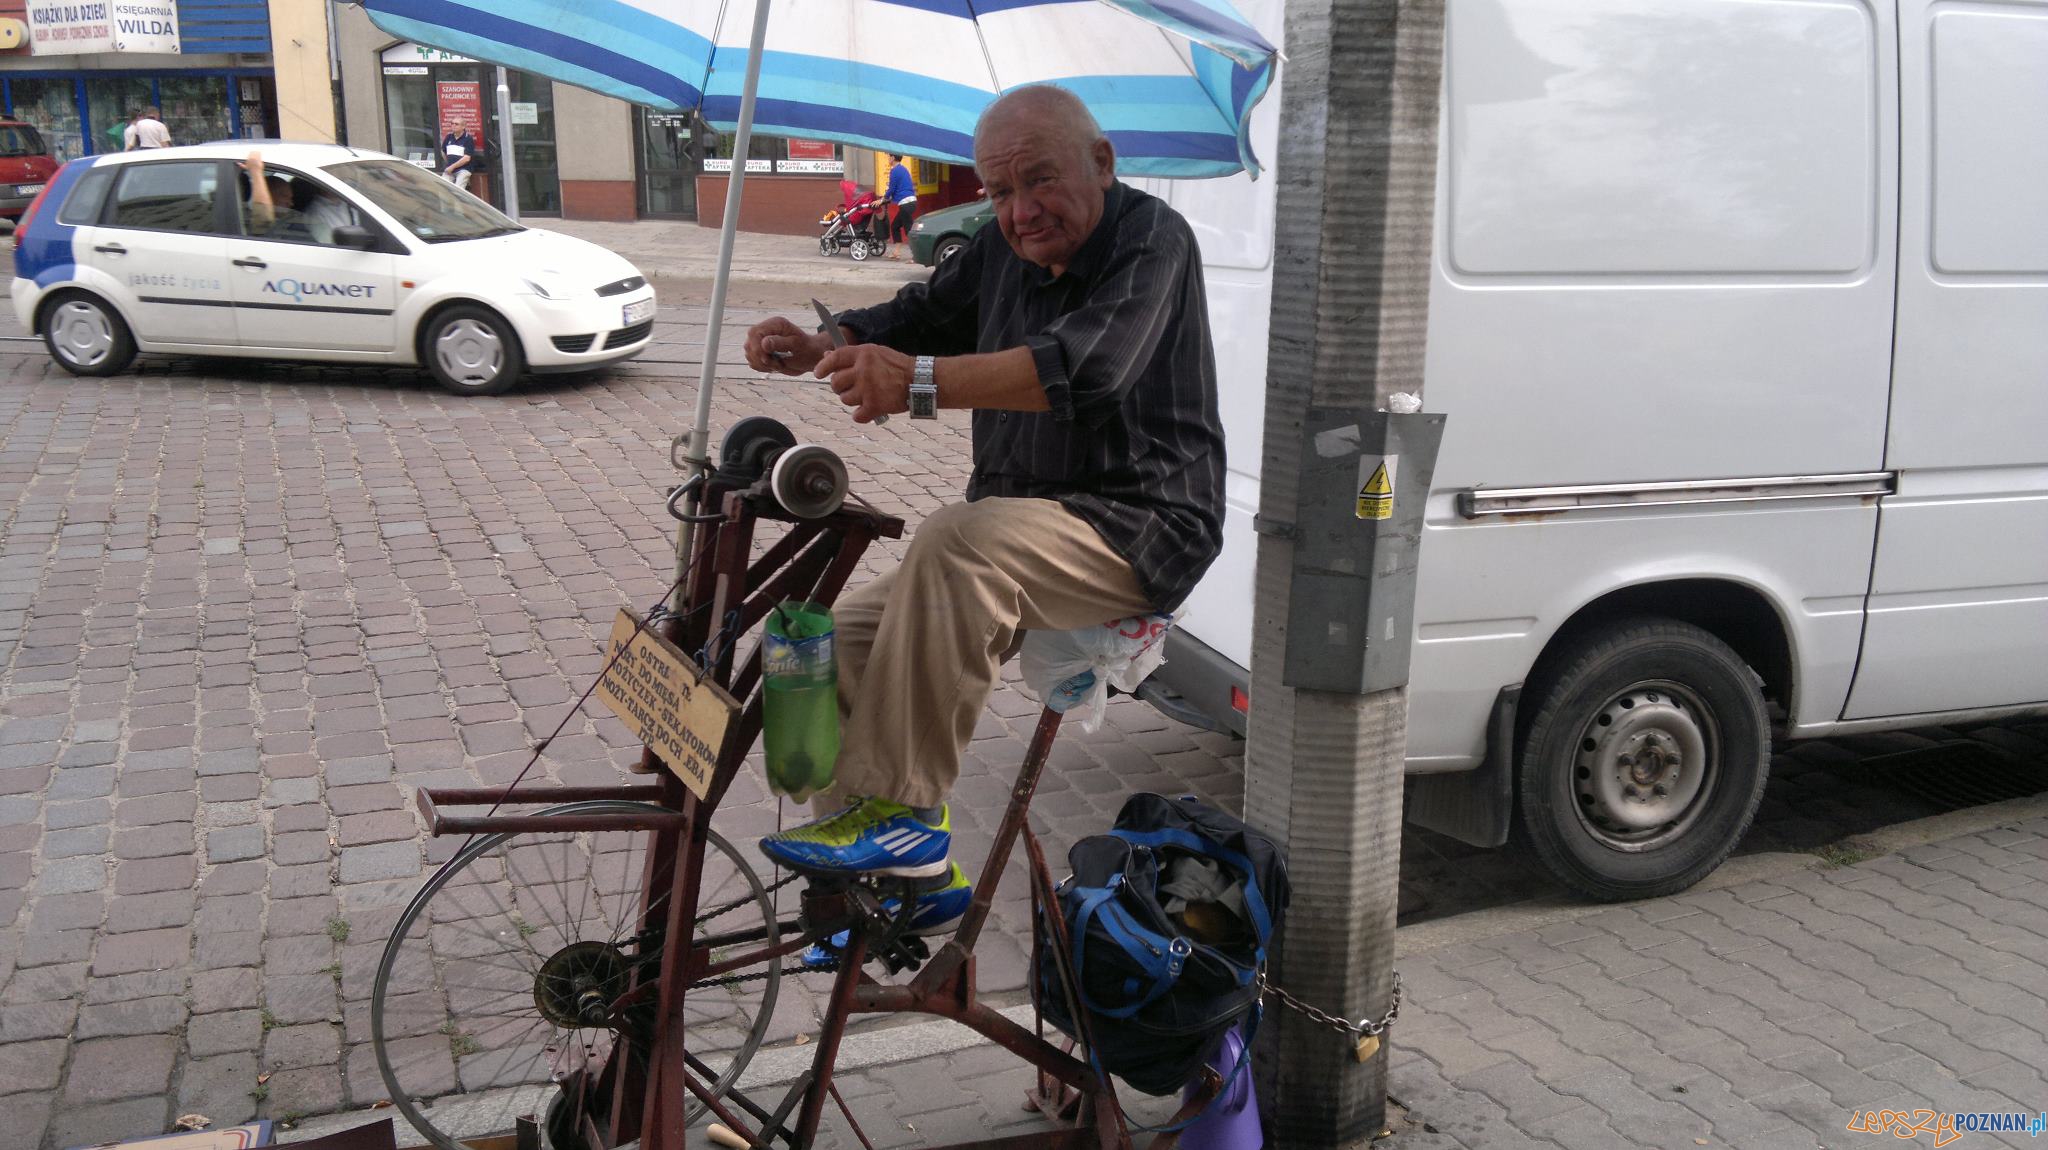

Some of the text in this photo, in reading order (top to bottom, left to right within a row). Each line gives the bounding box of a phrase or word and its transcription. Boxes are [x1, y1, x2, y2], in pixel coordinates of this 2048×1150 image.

[32, 2, 107, 27] KSIĄŻKI DLA DZIECI
[116, 5, 173, 16] KSIĘGARNIA
[117, 19, 175, 35] WILDA
[638, 663, 652, 685] DO
[651, 676, 680, 712] MIĘSA
[656, 723, 670, 745] DO
